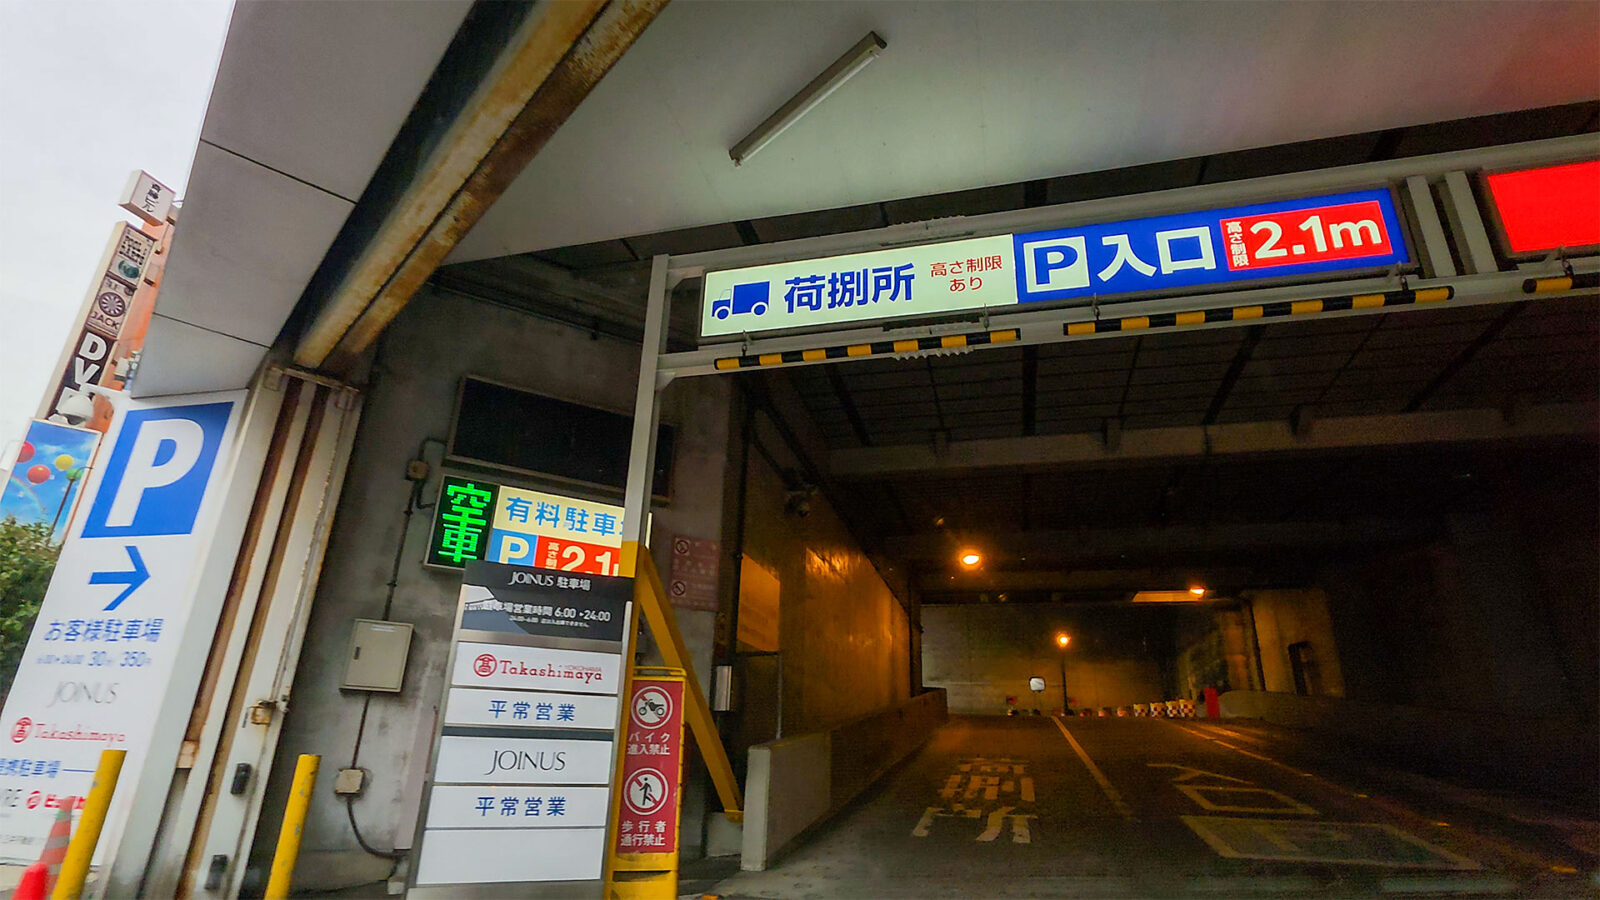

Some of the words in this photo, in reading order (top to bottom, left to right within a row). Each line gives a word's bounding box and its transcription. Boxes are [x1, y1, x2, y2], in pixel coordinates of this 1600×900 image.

[1225, 221, 1249, 267] 高さ制限
[1250, 215, 1382, 259] 2.1m
[930, 255, 1003, 278] 高さ制限
[1031, 242, 1080, 287] P
[1096, 226, 1216, 282] 入口
[783, 262, 916, 314] 荷捌所
[949, 276, 983, 293] あり
[91, 311, 120, 330] JACK
[104, 418, 204, 527] P
[438, 483, 492, 562] 空車
[505, 497, 624, 537] 有料駐車
[498, 535, 529, 564] P
[507, 571, 554, 587] JOINUS
[556, 576, 591, 591] 駐車場
[554, 607, 577, 619] 6:00
[584, 610, 611, 622] 24:00
[44, 618, 164, 643] お客様駐車場
[500, 660, 602, 684] Takashimaya
[488, 700, 576, 722] 平常営業
[35, 723, 126, 747] Takashimaya
[628, 732, 671, 743] バイク
[627, 743, 671, 755] 進入禁止
[483, 750, 566, 775] JOINUS
[475, 796, 566, 817] 平常営業
[622, 820, 667, 833] 歩行者
[620, 833, 665, 847] 通行禁止
